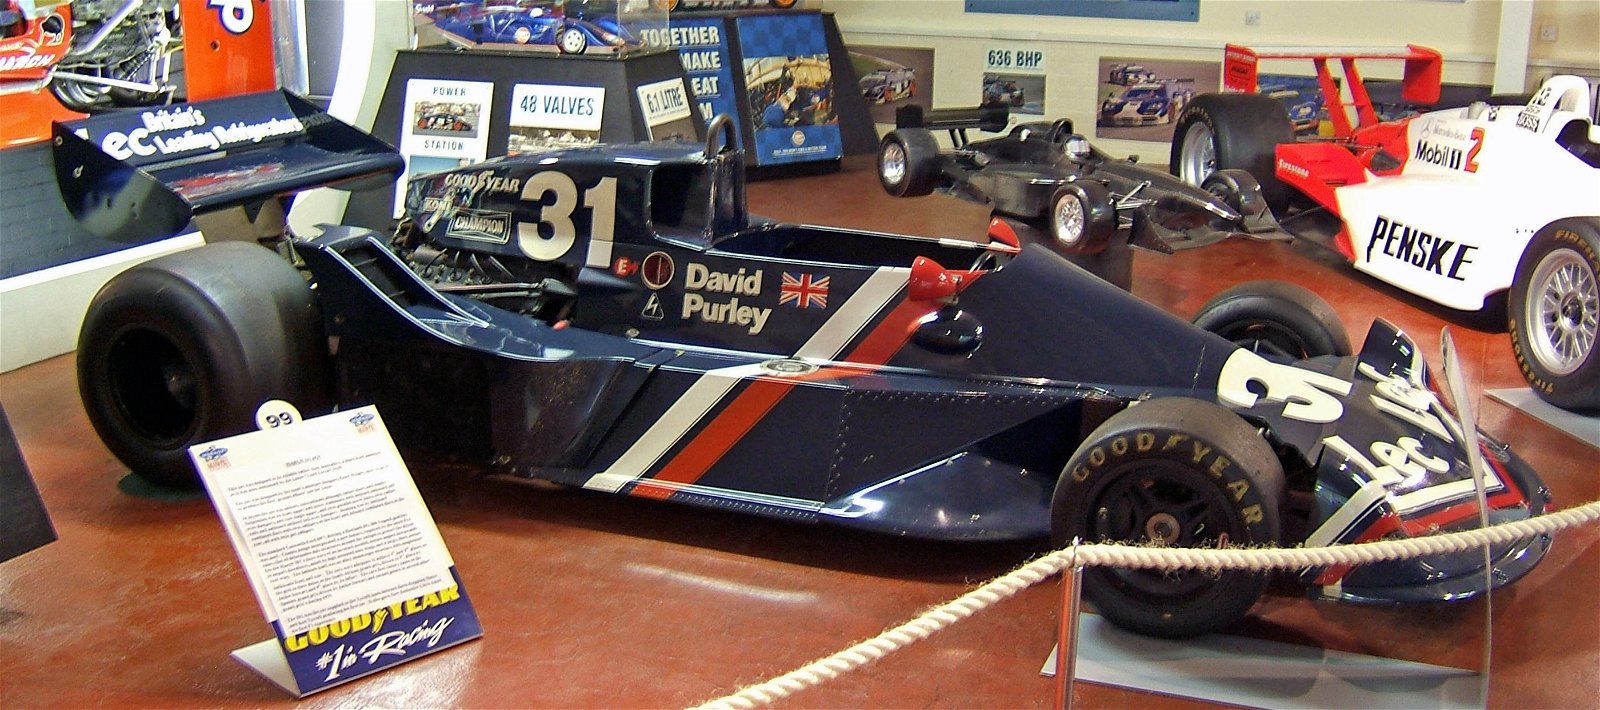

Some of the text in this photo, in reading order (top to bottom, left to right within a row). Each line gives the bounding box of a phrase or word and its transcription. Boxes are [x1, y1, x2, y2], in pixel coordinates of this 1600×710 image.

[415, 3, 435, 14] Gulf
[640, 26, 720, 48] TOGETHER
[988, 49, 1043, 67] 636 BHP
[432, 86, 467, 97] POWER
[646, 91, 661, 114] 6.1
[659, 86, 684, 109] LITRE
[691, 76, 719, 97] EAT
[519, 94, 595, 117] 48 VALVES
[141, 106, 206, 133] Britain's
[100, 127, 157, 161] ec
[424, 139, 465, 151] STATION
[1415, 139, 1462, 170] Mobil 1
[1463, 126, 1485, 173] 2
[454, 215, 505, 235] CHAMPION
[517, 170, 618, 269] 31
[1366, 214, 1479, 281] PENSKE
[684, 262, 763, 297] David
[681, 293, 772, 335] Purley
[265, 411, 294, 429] 99
[1322, 434, 1451, 492] Lec
[358, 616, 456, 665] Racing
